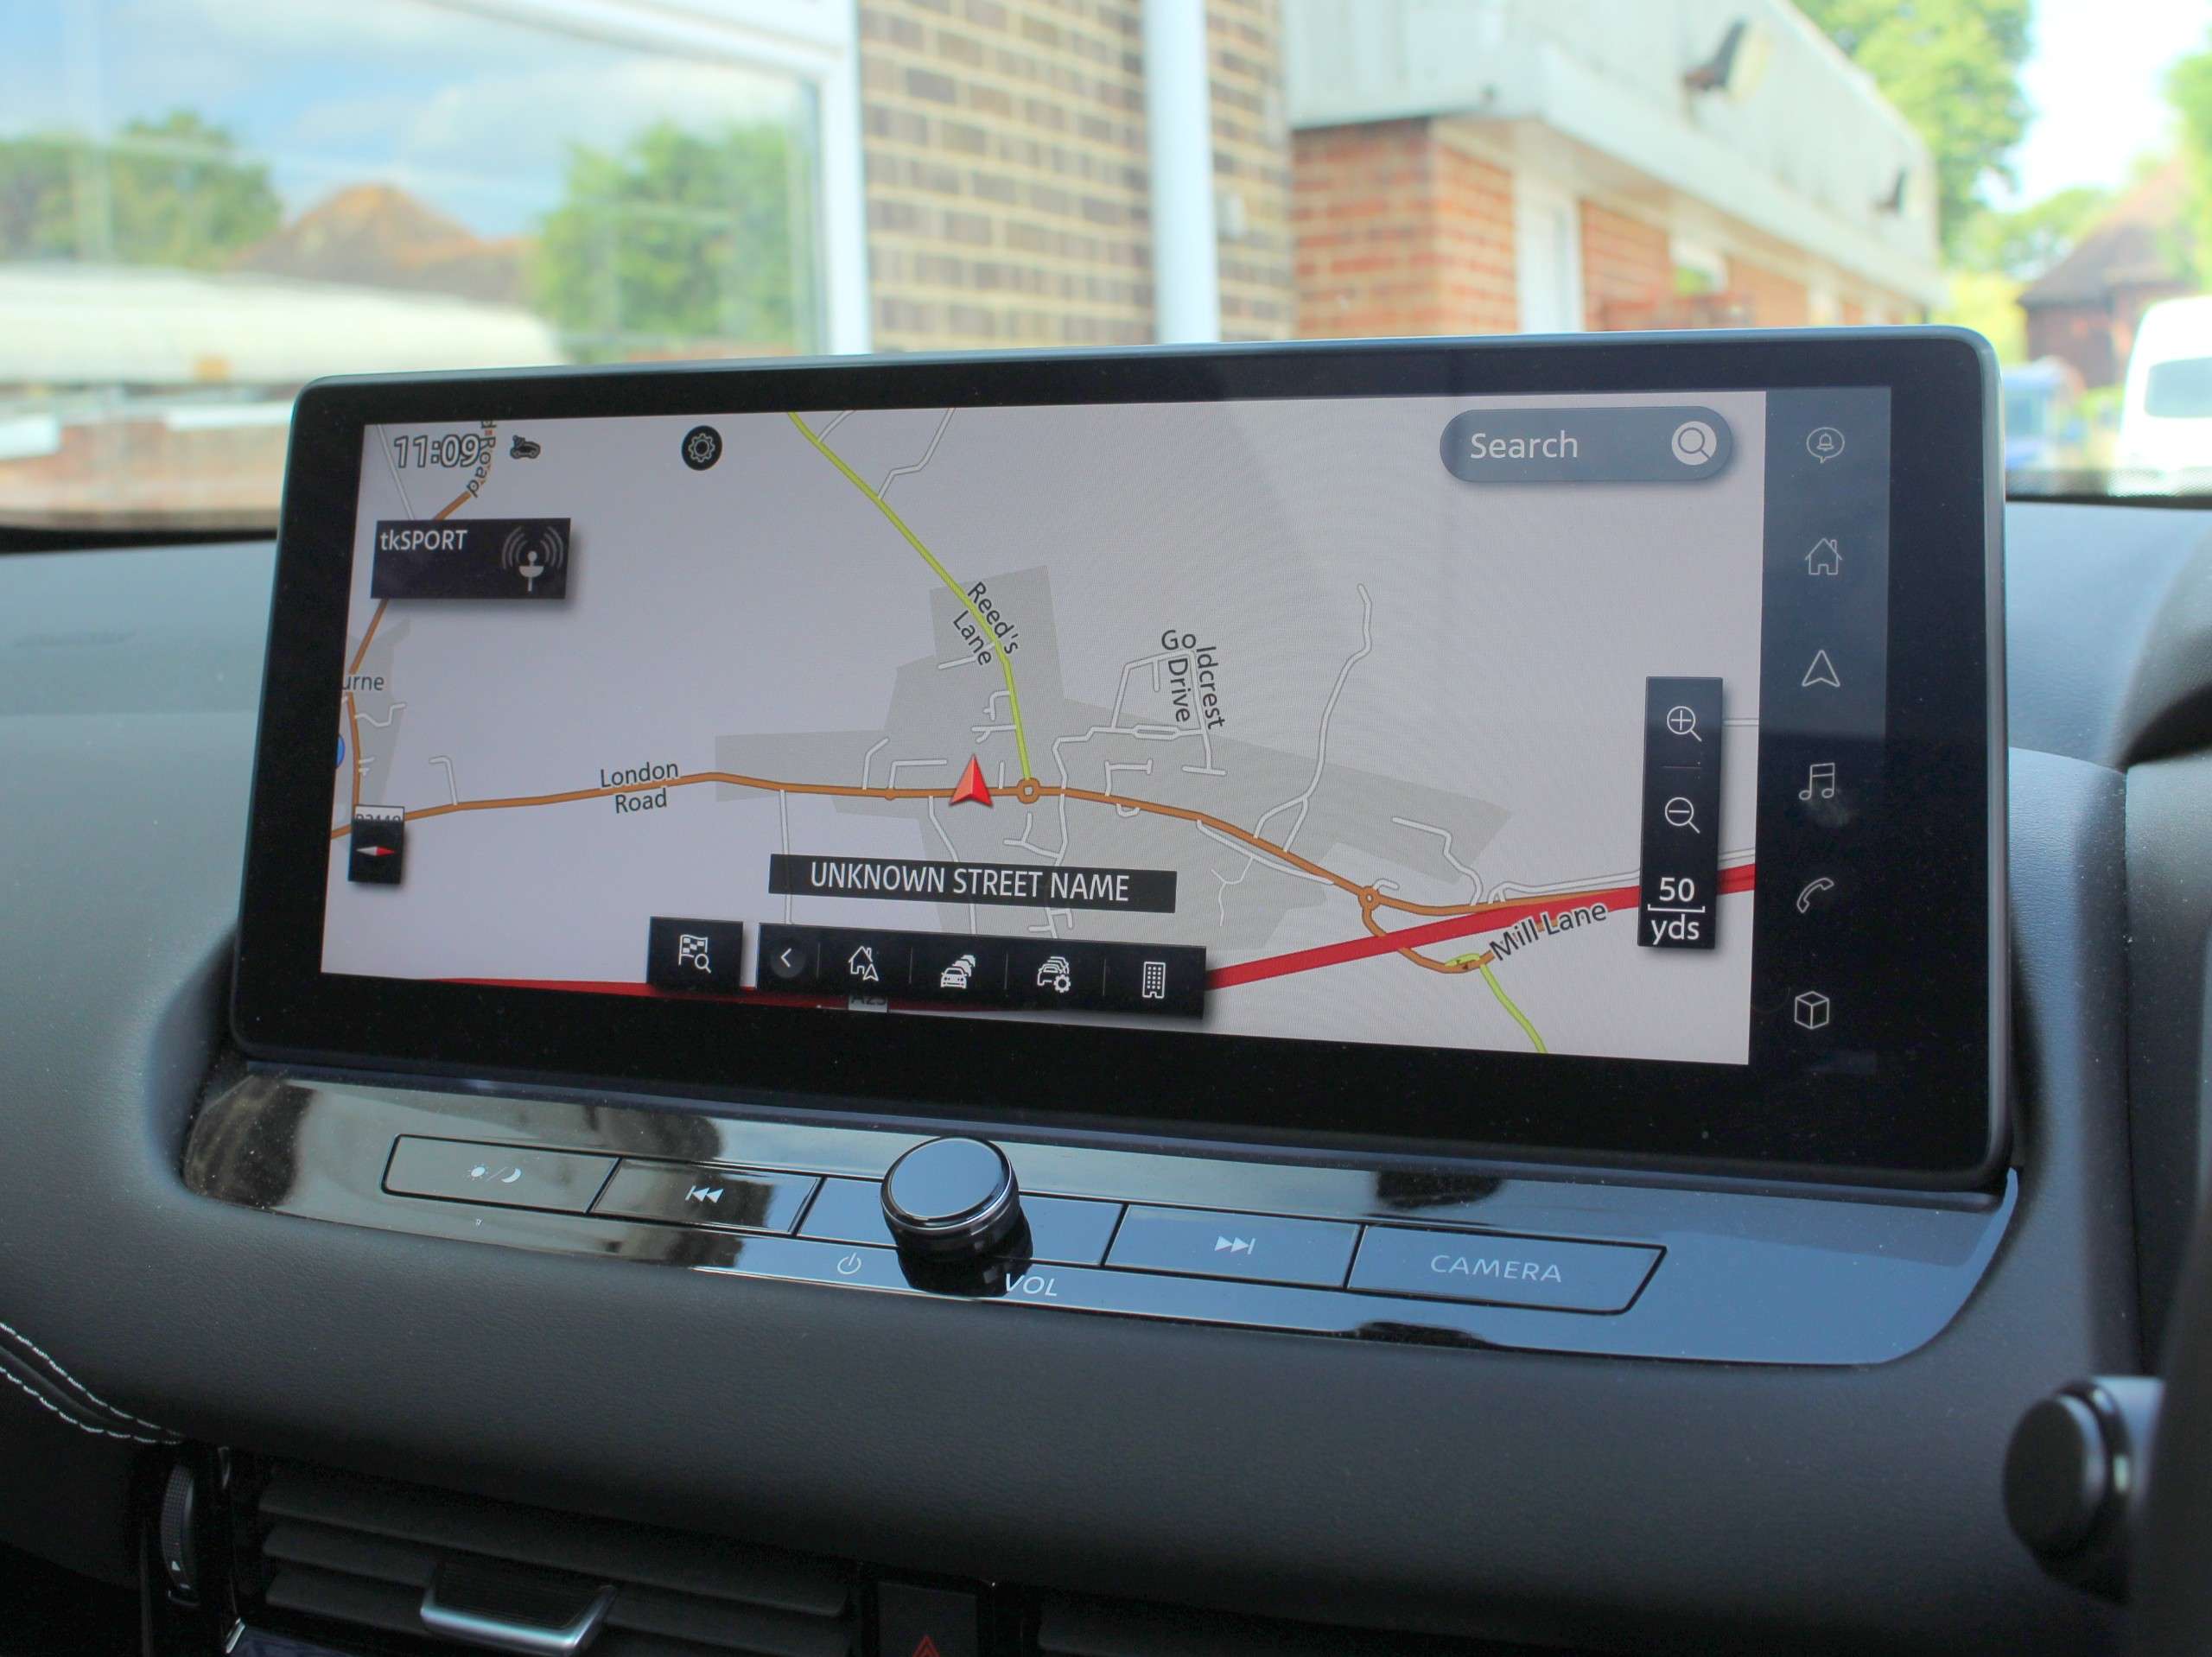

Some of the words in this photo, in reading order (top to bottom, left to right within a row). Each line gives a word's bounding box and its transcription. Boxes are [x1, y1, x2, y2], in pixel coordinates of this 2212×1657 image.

[394, 434, 480, 468] 11:09
[1470, 430, 1579, 459] Search
[467, 436, 496, 498] Road
[379, 530, 467, 551] tkSPORT
[967, 581, 1018, 655] Reed's
[953, 610, 992, 665] Lane
[1161, 630, 1225, 729] Goldcrest
[1168, 658, 1191, 722] Drive
[601, 760, 679, 789] London
[615, 789, 668, 814] Road
[811, 862, 945, 892] UNKNOWN
[953, 868, 1043, 898] STREET
[1051, 873, 1129, 901] NAME
[1659, 878, 1695, 902] 50
[1490, 918, 1539, 961] Mill
[1542, 903, 1607, 936] Lane
[1651, 914, 1700, 945] yds
[1430, 1254, 1562, 1283] CAMERA
[1006, 1273, 1058, 1297] VOL
